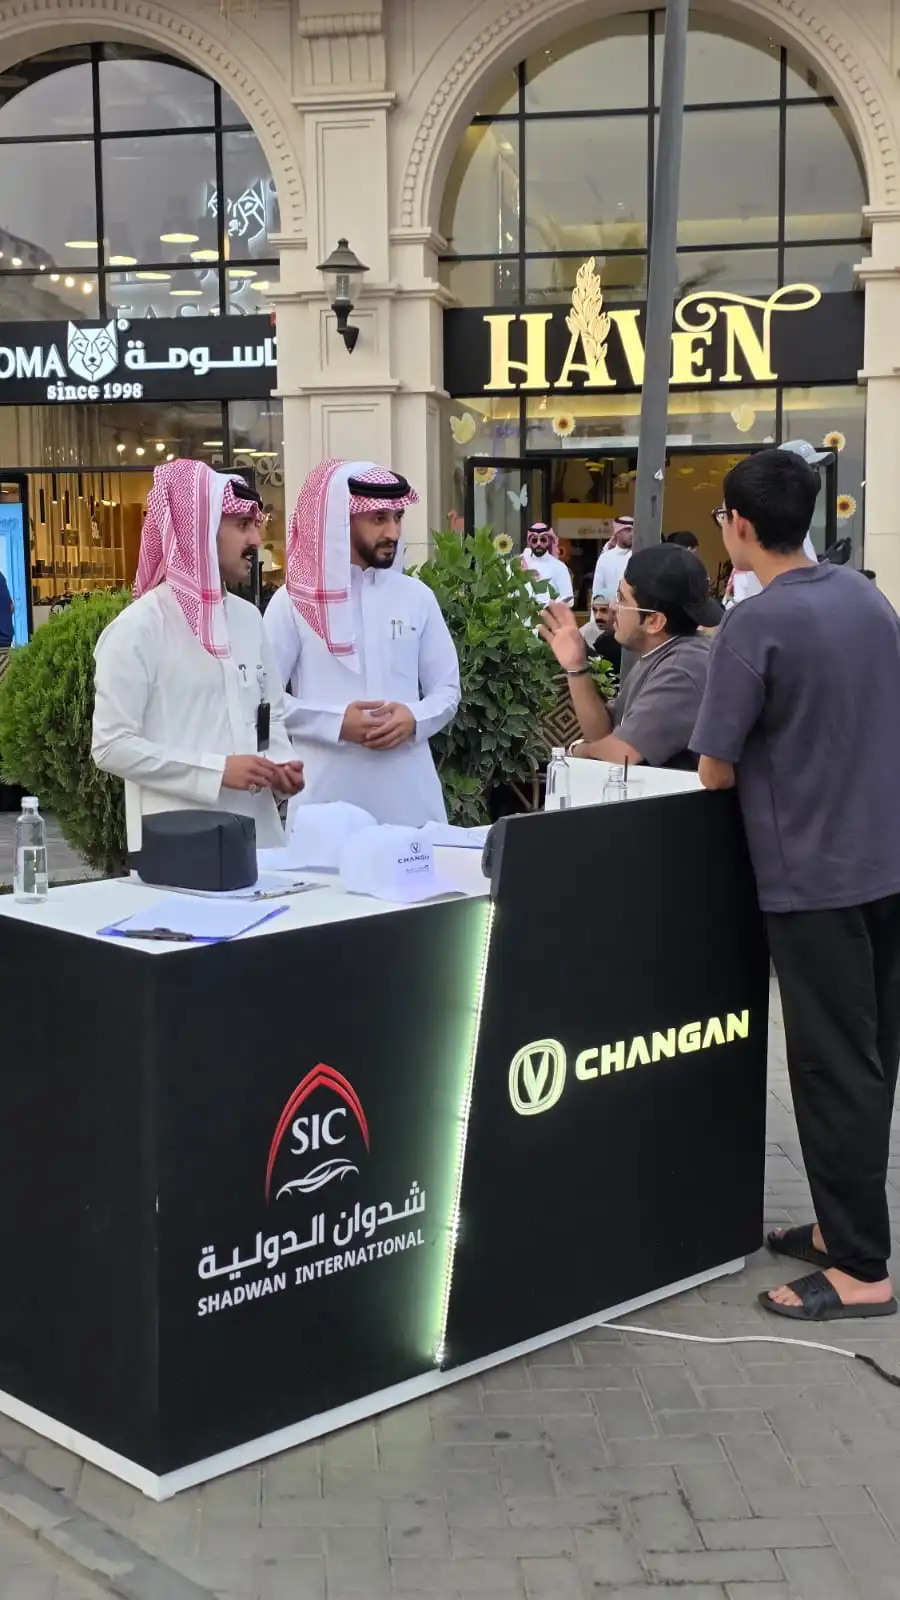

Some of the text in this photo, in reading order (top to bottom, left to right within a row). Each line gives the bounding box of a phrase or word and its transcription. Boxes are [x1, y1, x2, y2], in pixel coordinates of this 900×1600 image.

[0, 344, 67, 378] OMA
[47, 382, 143, 400] since 1998
[575, 1009, 749, 1081] CHANGAN
[290, 1107, 347, 1155] SIC
[198, 1180, 426, 1280] شدوان الدولية
[197, 1229, 425, 1316] SHADWAN INTERNATIONAL
